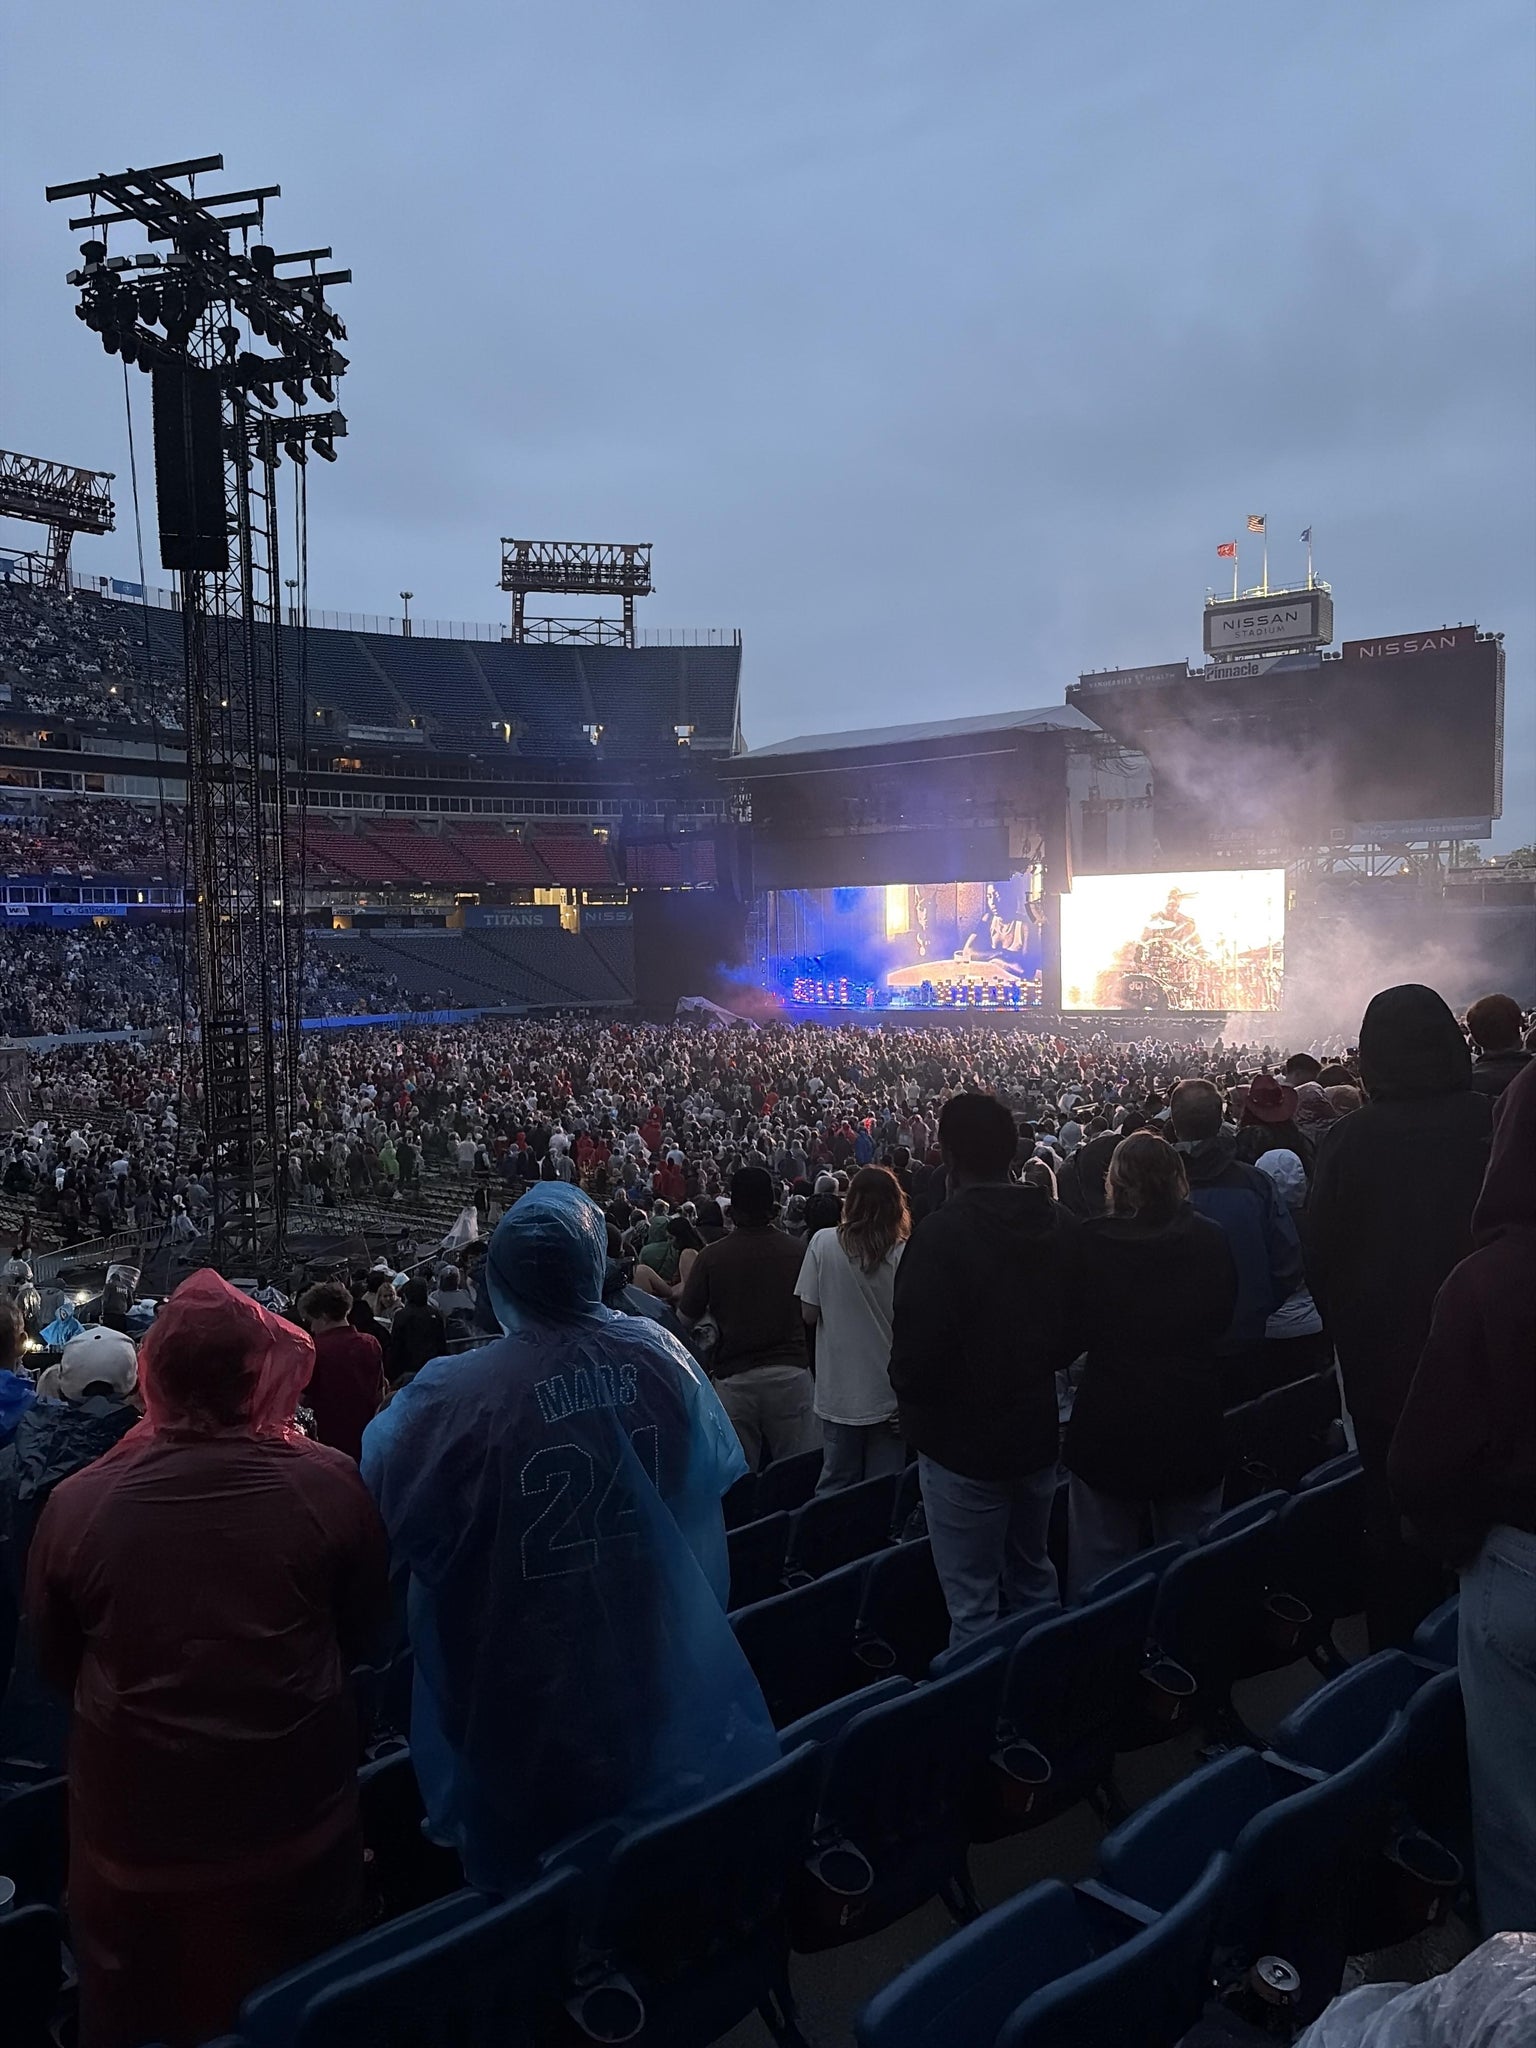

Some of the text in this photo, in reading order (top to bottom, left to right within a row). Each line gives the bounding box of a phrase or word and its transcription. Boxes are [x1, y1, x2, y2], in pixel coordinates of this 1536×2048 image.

[1223, 611, 1298, 630] NISSAN
[1234, 625, 1286, 639] STADIUM
[1359, 635, 1456, 659] NISSAN
[1206, 662, 1260, 680] Pinnacle
[483, 914, 544, 927] TITANS
[520, 1423, 660, 1581] 24
